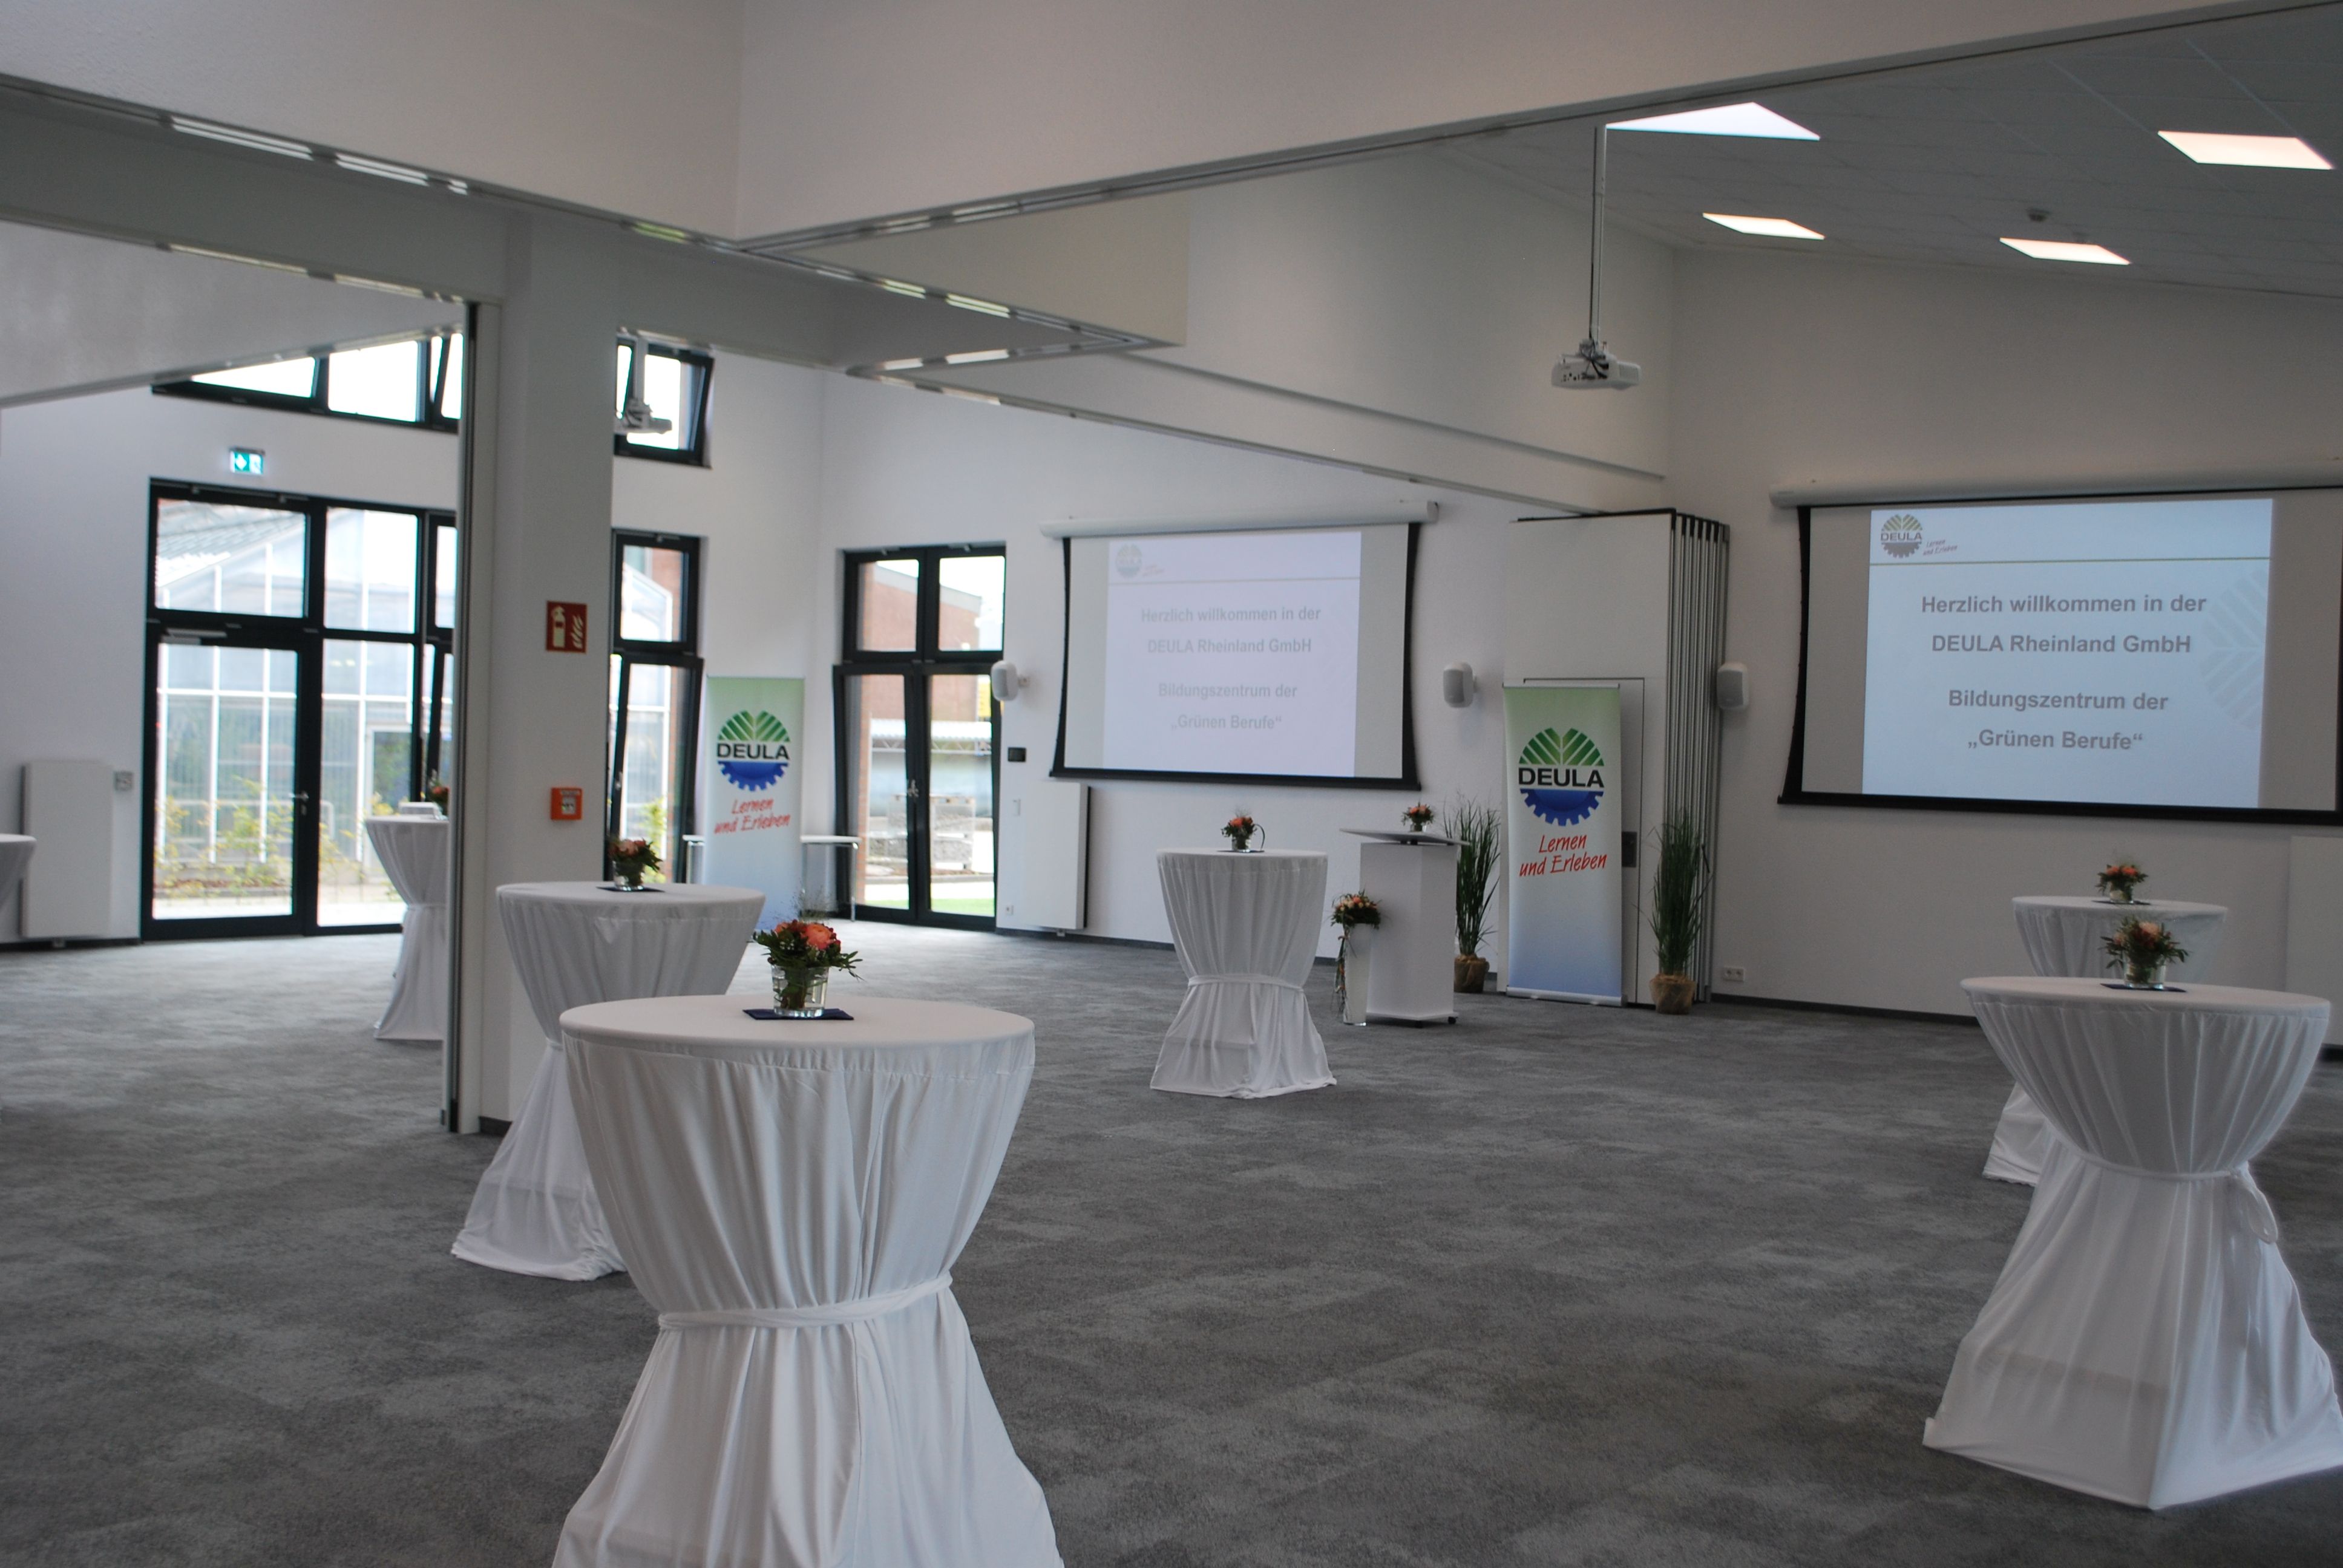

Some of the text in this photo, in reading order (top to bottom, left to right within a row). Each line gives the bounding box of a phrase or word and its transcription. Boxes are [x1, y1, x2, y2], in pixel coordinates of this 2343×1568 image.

[1881, 532, 1922, 541] DEULA
[1921, 595, 2206, 613] Herzlich willkommen in der
[1142, 606, 1320, 622] Herzlich willkommen in der
[1148, 639, 1312, 653] DEULA Rheinland GmbH
[1932, 635, 2191, 653] DEULA Rheinland GmbH
[1158, 682, 1297, 700] Bildungszentrum der
[1948, 690, 2168, 711] Bildungszentrum der
[1967, 730, 2142, 750] „Grünen Berufe“
[717, 743, 790, 760] DEULA
[1518, 767, 1605, 788] DEULA
[732, 799, 774, 814] Lernen
[714, 814, 790, 834] und Erleben
[1539, 834, 1587, 853] Lernen
[1519, 852, 1608, 877] und Erleben
